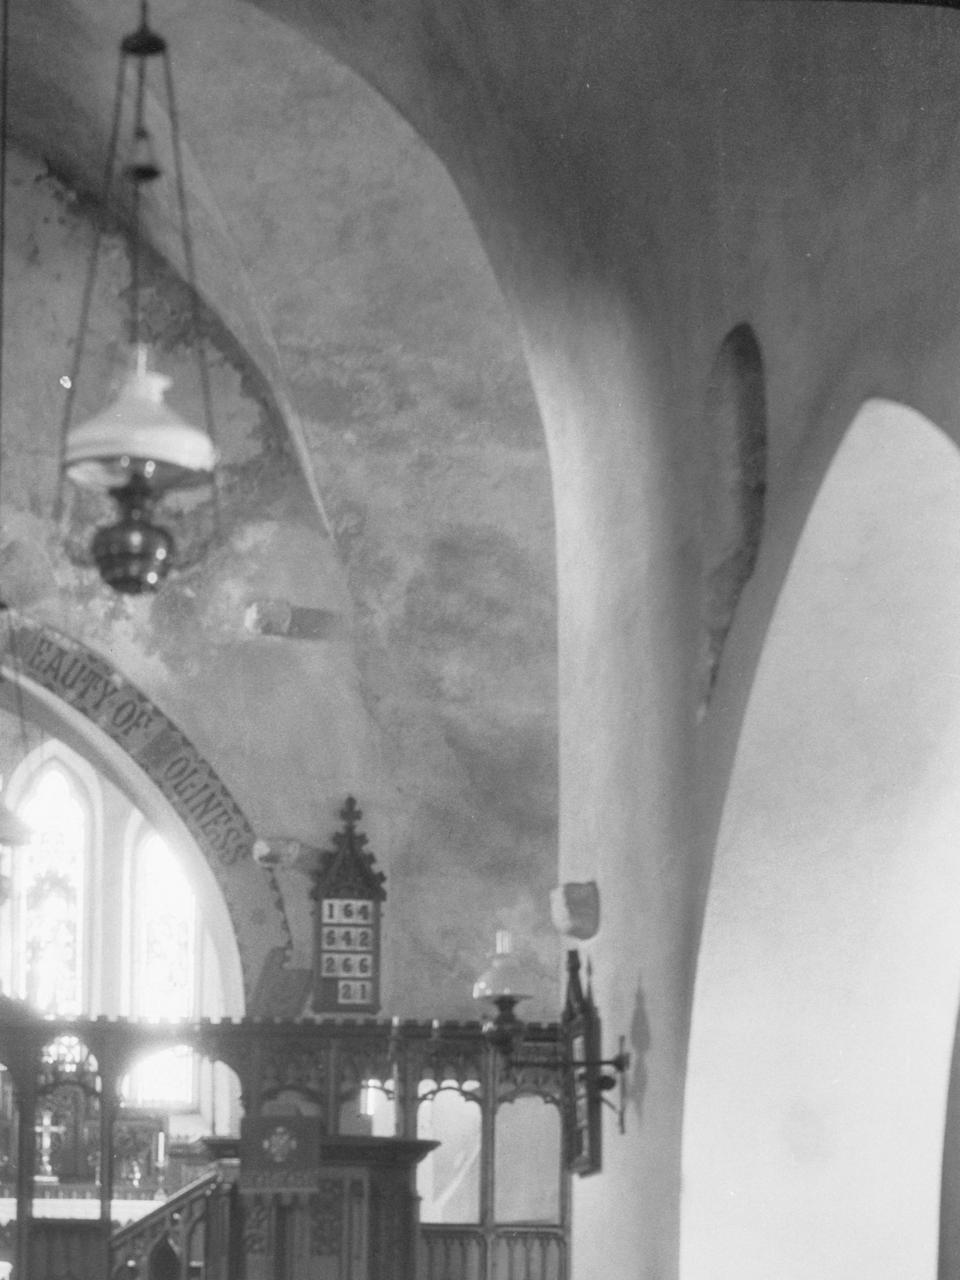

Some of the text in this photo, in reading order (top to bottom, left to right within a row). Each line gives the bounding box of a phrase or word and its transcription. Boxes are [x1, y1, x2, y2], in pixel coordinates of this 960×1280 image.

[15, 628, 119, 710] EAUTY
[111, 701, 153, 736] OF
[148, 738, 241, 866] OLINESS
[327, 903, 370, 920] 164
[326, 956, 370, 974] 266
[342, 984, 367, 999] 21
